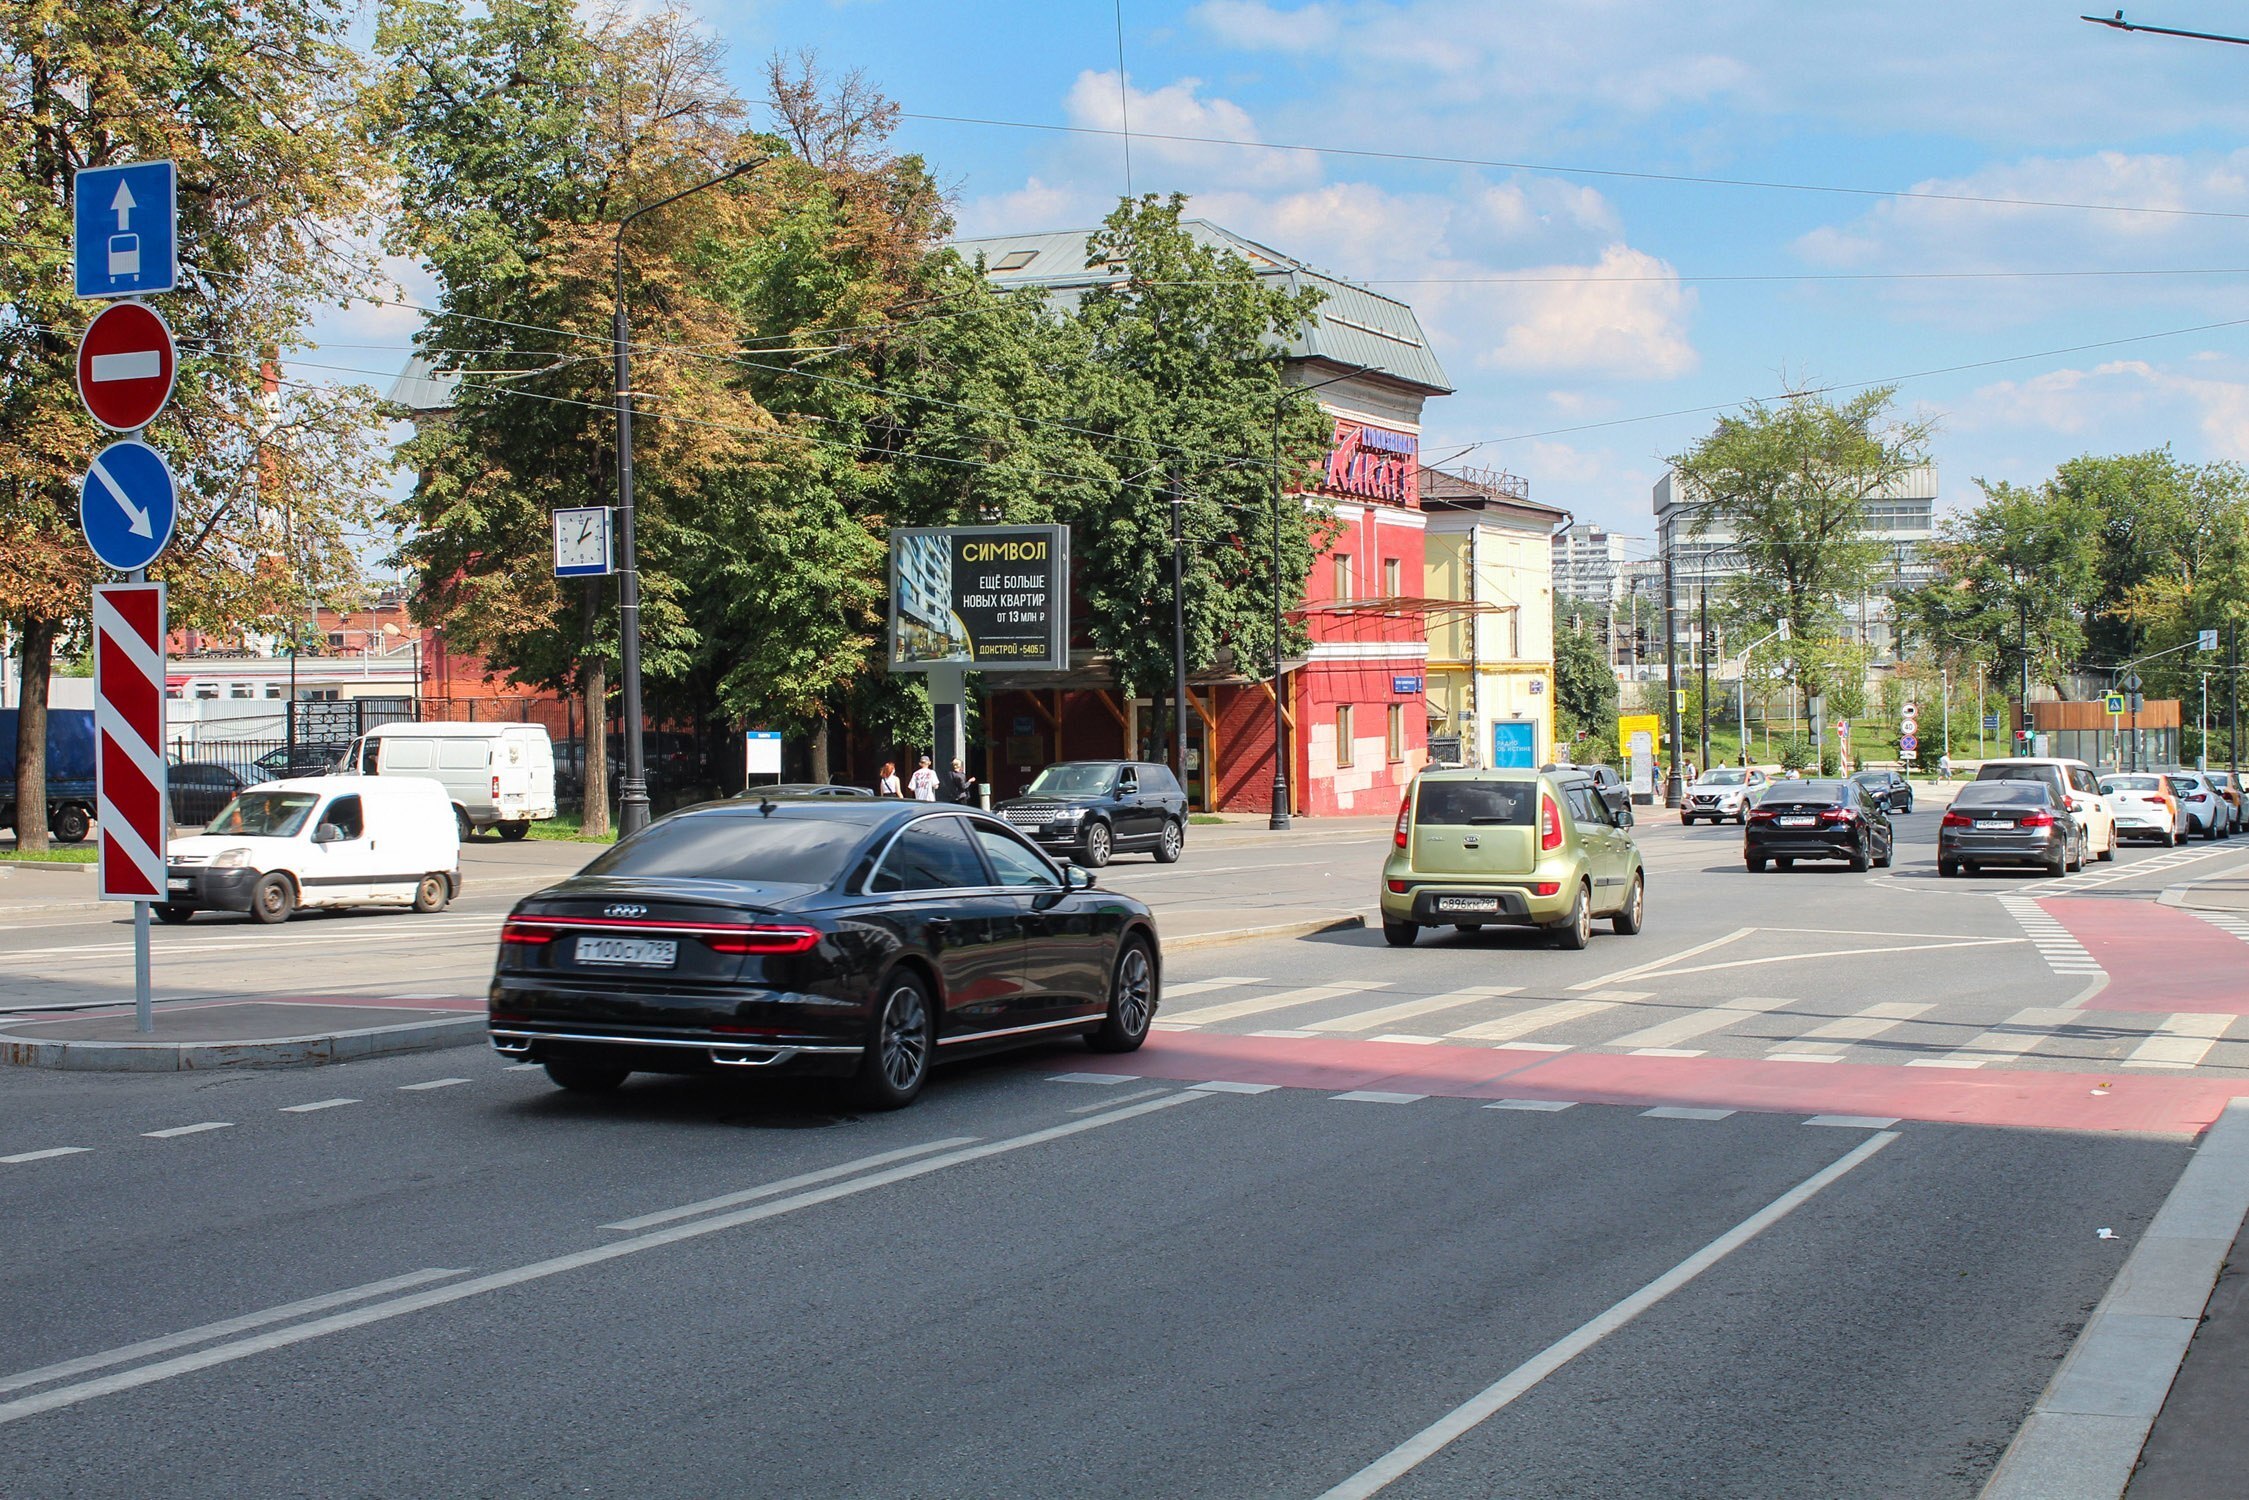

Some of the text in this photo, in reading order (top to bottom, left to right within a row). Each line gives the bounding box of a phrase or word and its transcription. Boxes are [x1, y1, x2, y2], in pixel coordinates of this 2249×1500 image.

[1326, 427, 1413, 502] KARATE
[962, 541, 1047, 562] СИМВОЛ
[979, 574, 1045, 590] ЕЩЁ БОЛЬШЕ
[963, 593, 1046, 608] НОВЫХ КВАРТИР
[997, 612, 1007, 623] ОТ
[1008, 611, 1019, 622] 13
[1020, 612, 1037, 622] МЛН
[979, 643, 1018, 655] ДОНСТРОЙ
[1904, 723, 1914, 731] 40
[1496, 739, 1518, 747] РАДИО
